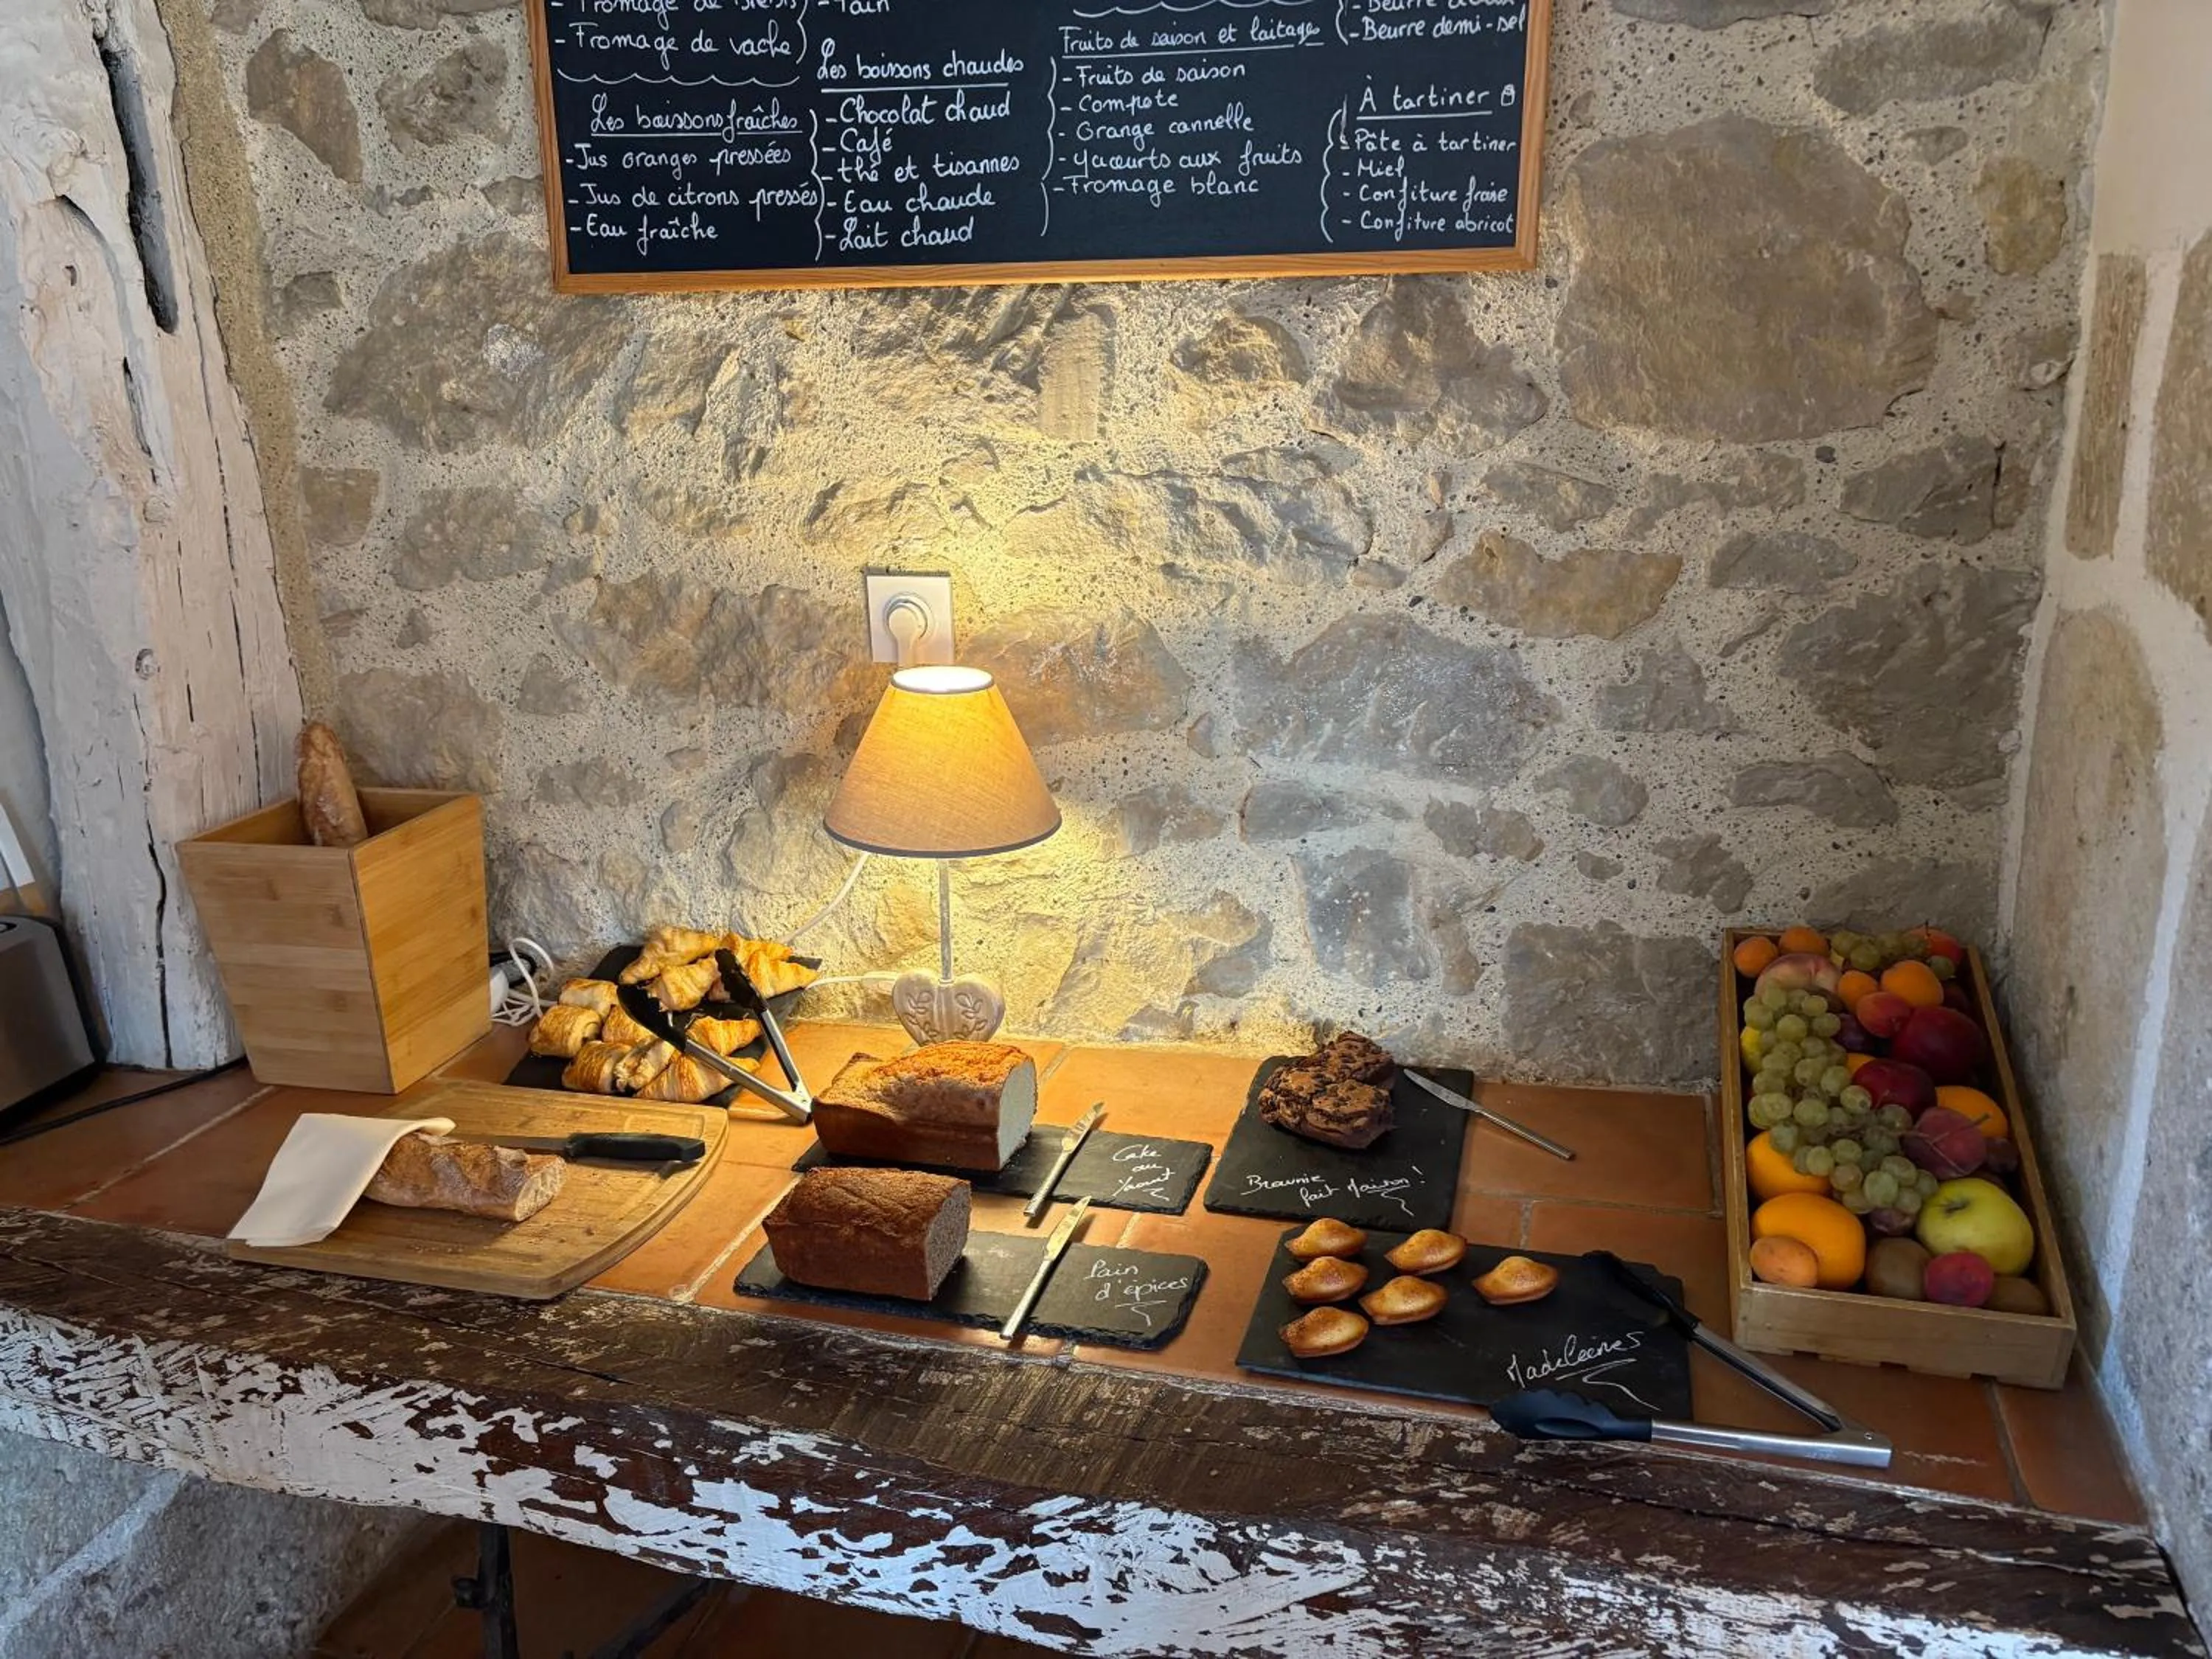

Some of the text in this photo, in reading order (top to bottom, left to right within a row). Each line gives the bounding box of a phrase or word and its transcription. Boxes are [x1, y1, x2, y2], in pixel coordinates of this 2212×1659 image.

[568, 19, 792, 70] Fromage de vache
[1059, 15, 1321, 54] Fruits de saison et laitages
[1362, 15, 1425, 41] Beurre
[816, 38, 1025, 80] Les boissons chaudes
[1076, 58, 1246, 88] Fruits de saison
[840, 88, 1011, 125] Chocolat chaud
[1079, 88, 1180, 116] Compote
[1393, 83, 1490, 111] tartiner
[591, 92, 798, 143] Les boissons fraîches
[1168, 101, 1255, 134] cannelle
[840, 126, 893, 165] Café
[1354, 128, 1517, 152] Pâte à tartiner
[574, 141, 791, 180] Jus oranges pressées
[894, 154, 919, 182] et
[932, 152, 1020, 177] tisannes
[1179, 150, 1221, 170] aux
[1238, 139, 1303, 176] fruits
[1357, 154, 1405, 178] Miel
[580, 182, 818, 222] Jus de citrons pressés
[844, 182, 995, 214] Eau chaude
[1062, 170, 1259, 208] Fromage blanc
[1360, 175, 1509, 214] Confiture fraise
[587, 211, 718, 257] Eau fraîche
[839, 215, 974, 251] Lait chaud
[1360, 207, 1514, 243] Confiture abricot
[1112, 1144, 1162, 1162] Cake
[1132, 1164, 1164, 1172] au
[1241, 1174, 1325, 1196] Brownie
[1300, 1183, 1340, 1208] fait
[1083, 1259, 1139, 1280] Pain
